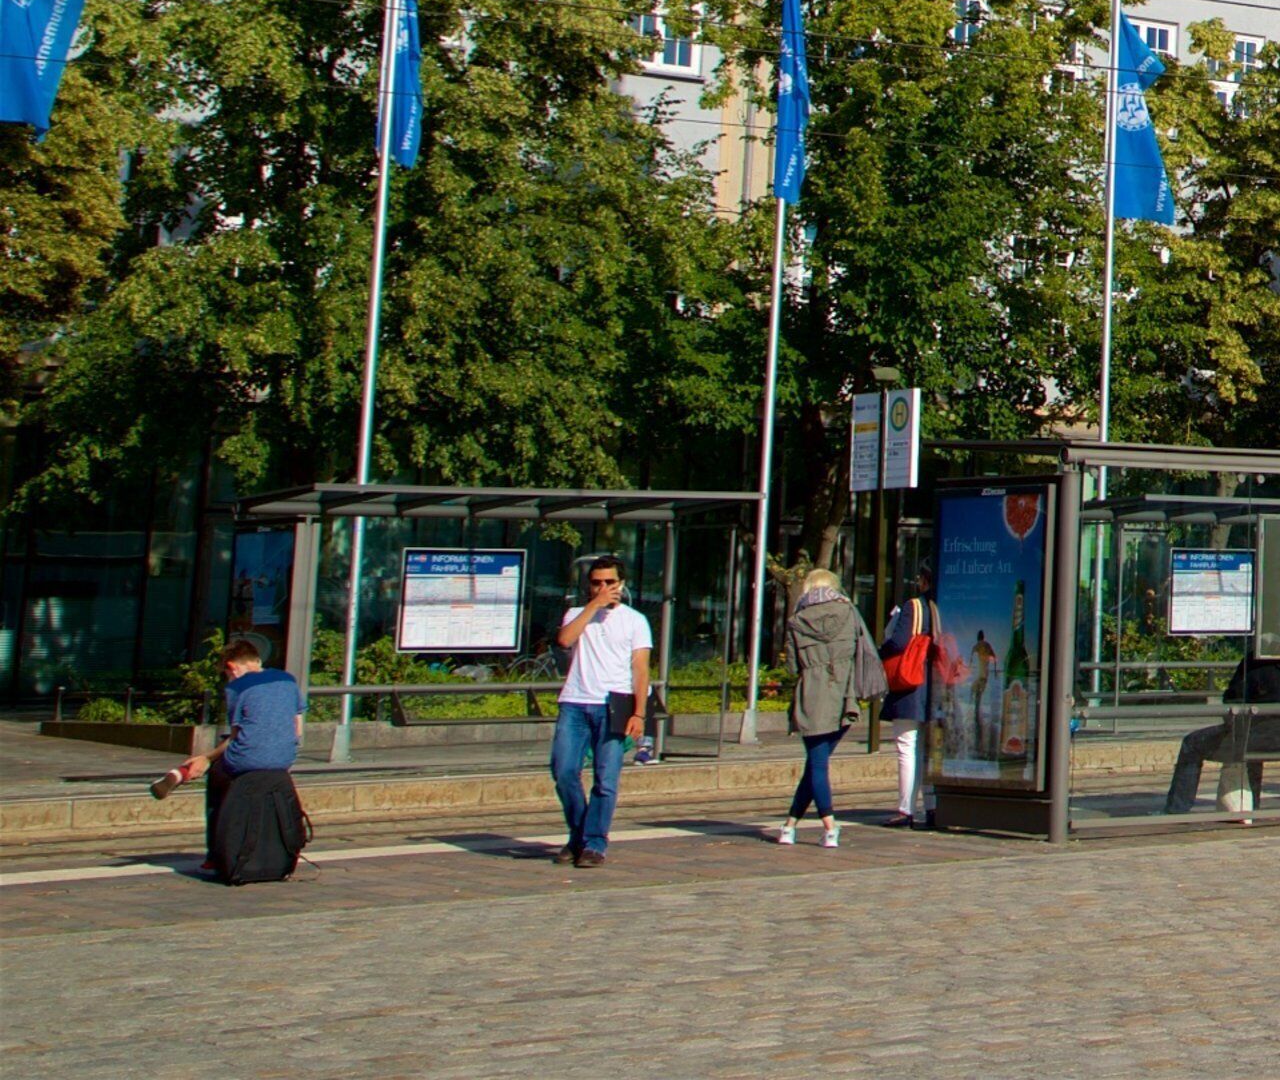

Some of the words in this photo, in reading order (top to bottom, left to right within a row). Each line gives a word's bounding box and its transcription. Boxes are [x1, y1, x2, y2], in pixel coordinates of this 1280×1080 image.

[943, 536, 997, 556] Erfrischung
[431, 554, 495, 563] INFORMAONEN
[1190, 553, 1235, 562] INFORMAONEN
[431, 563, 477, 573] FAHRPLÄE
